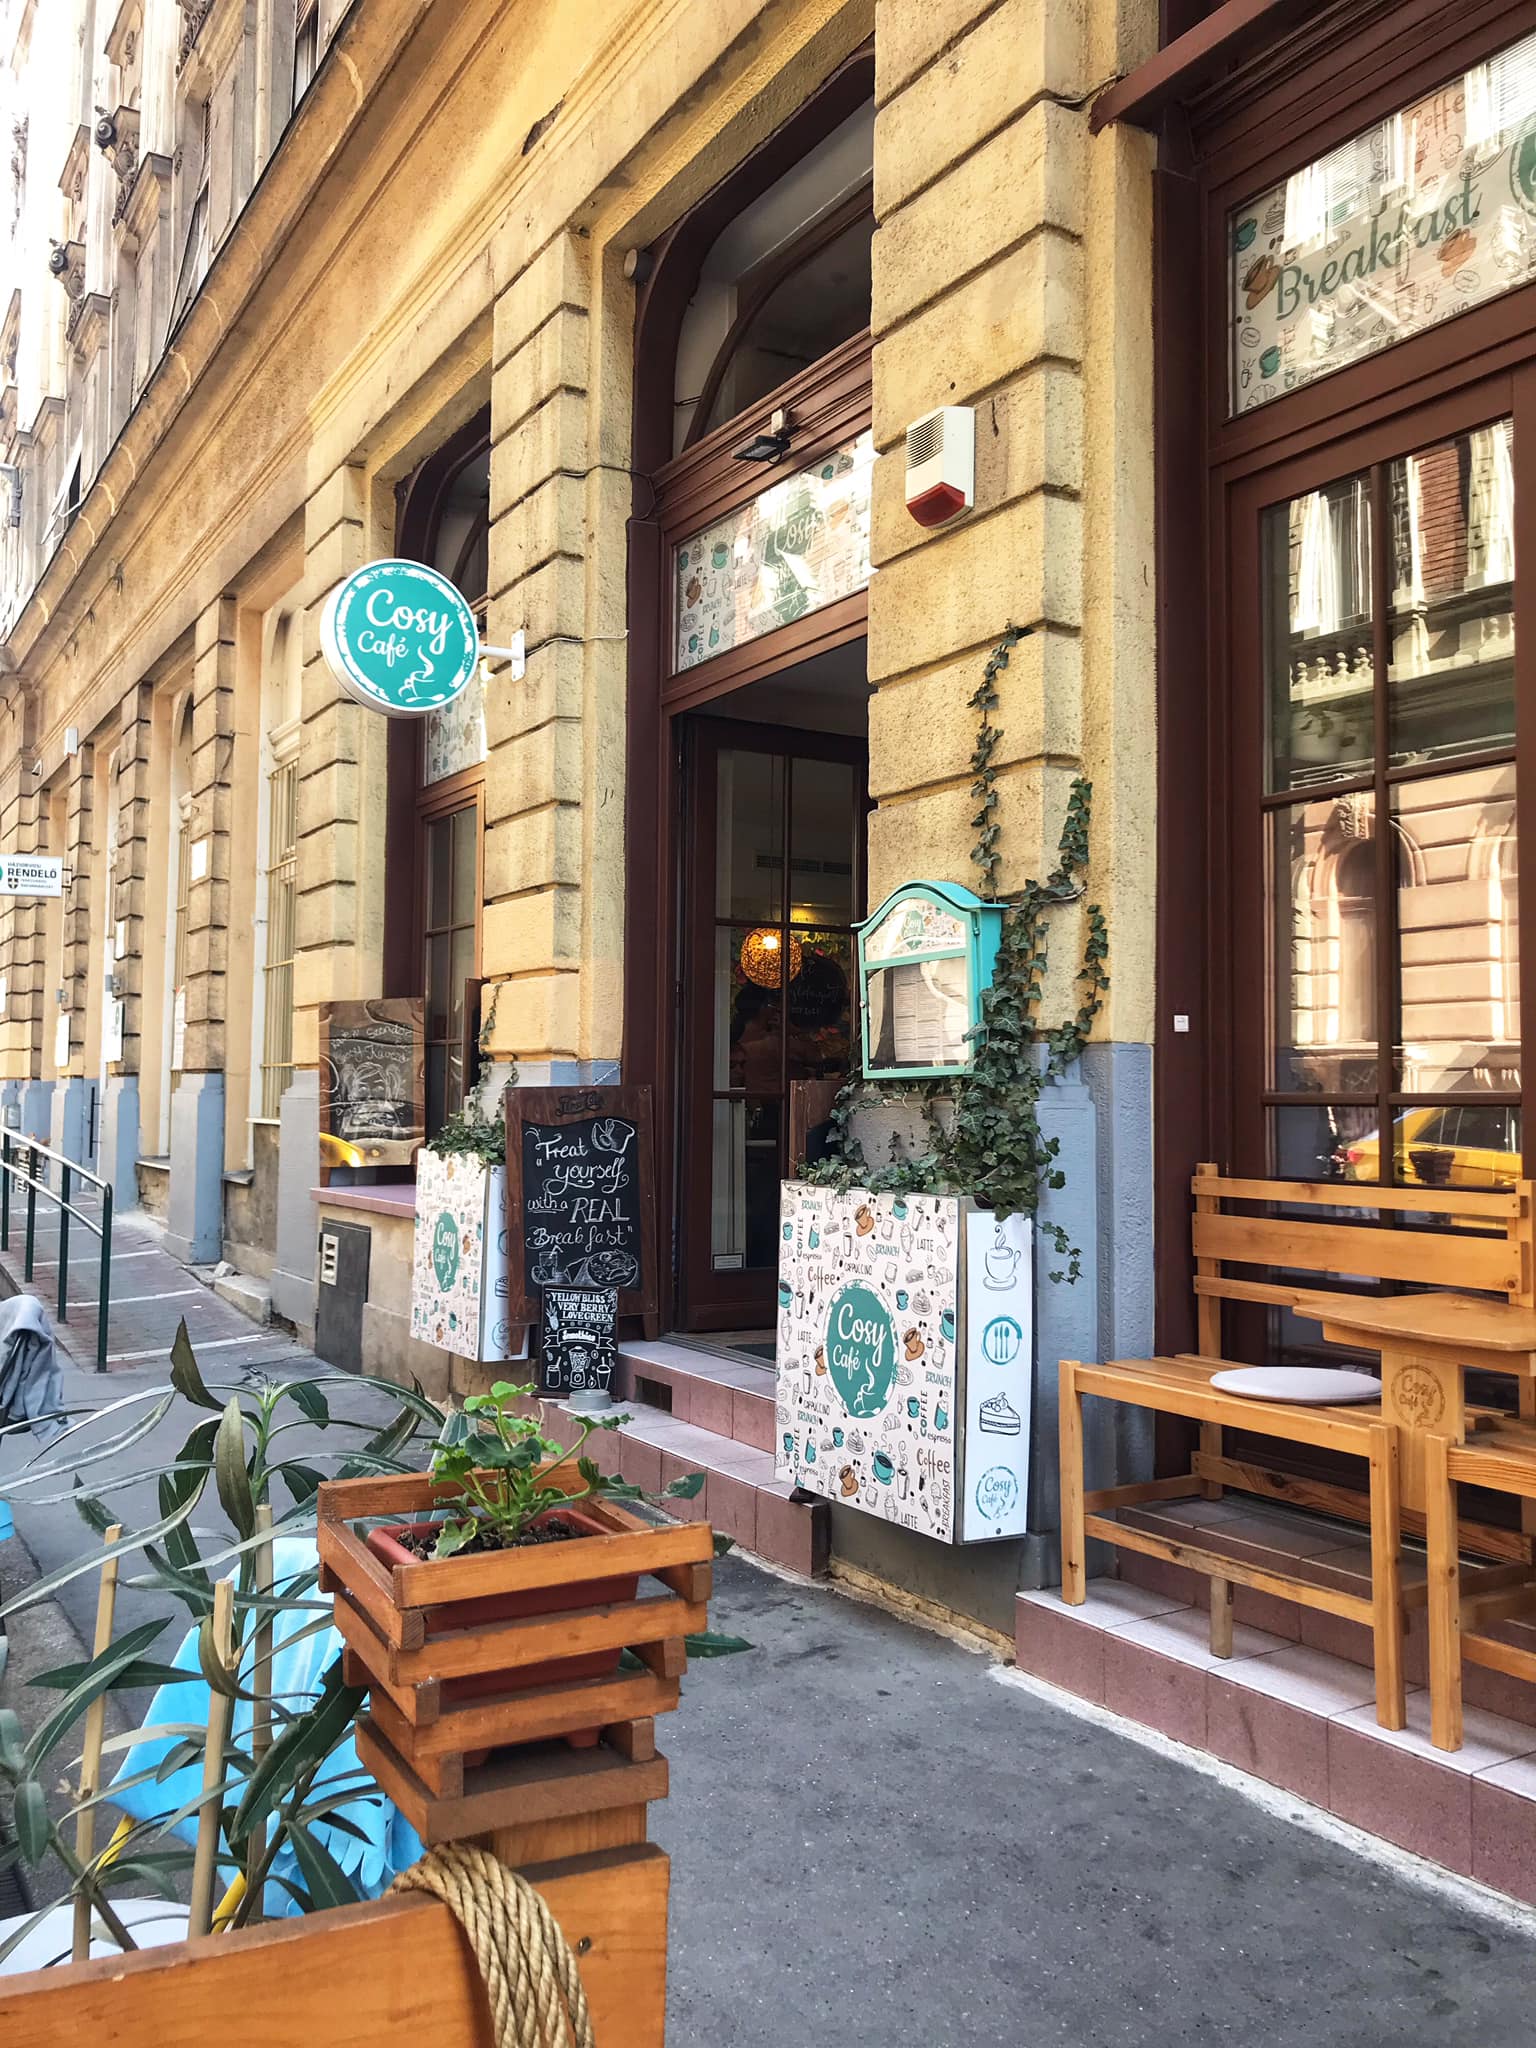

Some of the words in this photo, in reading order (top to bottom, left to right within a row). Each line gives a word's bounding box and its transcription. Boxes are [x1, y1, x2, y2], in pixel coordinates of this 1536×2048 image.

[1411, 93, 1465, 138] Coffe
[1276, 178, 1480, 320] Breakfast
[366, 589, 453, 655] Cosy
[357, 631, 409, 667] Café
[535, 1133, 589, 1161] Treat
[528, 1192, 557, 1210] with
[560, 1201, 568, 1210] a
[569, 1197, 630, 1223] REAL
[437, 1222, 456, 1260] Cosy
[916, 1239, 934, 1253] LATTE
[808, 1267, 836, 1293] Coffee
[551, 1292, 581, 1303] YELLOW
[582, 1294, 606, 1304] BLISS
[558, 1302, 579, 1311] VERY
[580, 1303, 611, 1313] BERRY
[562, 1311, 583, 1320] LOVE
[584, 1312, 614, 1322] GREEN
[797, 1330, 812, 1344] LATTE
[838, 1303, 887, 1367] Cosy
[832, 1344, 861, 1380] Café
[925, 1371, 952, 1387] BRUNCH
[1402, 1374, 1437, 1407] Cosy
[919, 1391, 928, 1437] COFFEE
[927, 1432, 952, 1444] espresso
[917, 1448, 951, 1480] Coffee
[984, 1476, 1011, 1497] Cosy
[900, 1511, 918, 1529] LATTE
